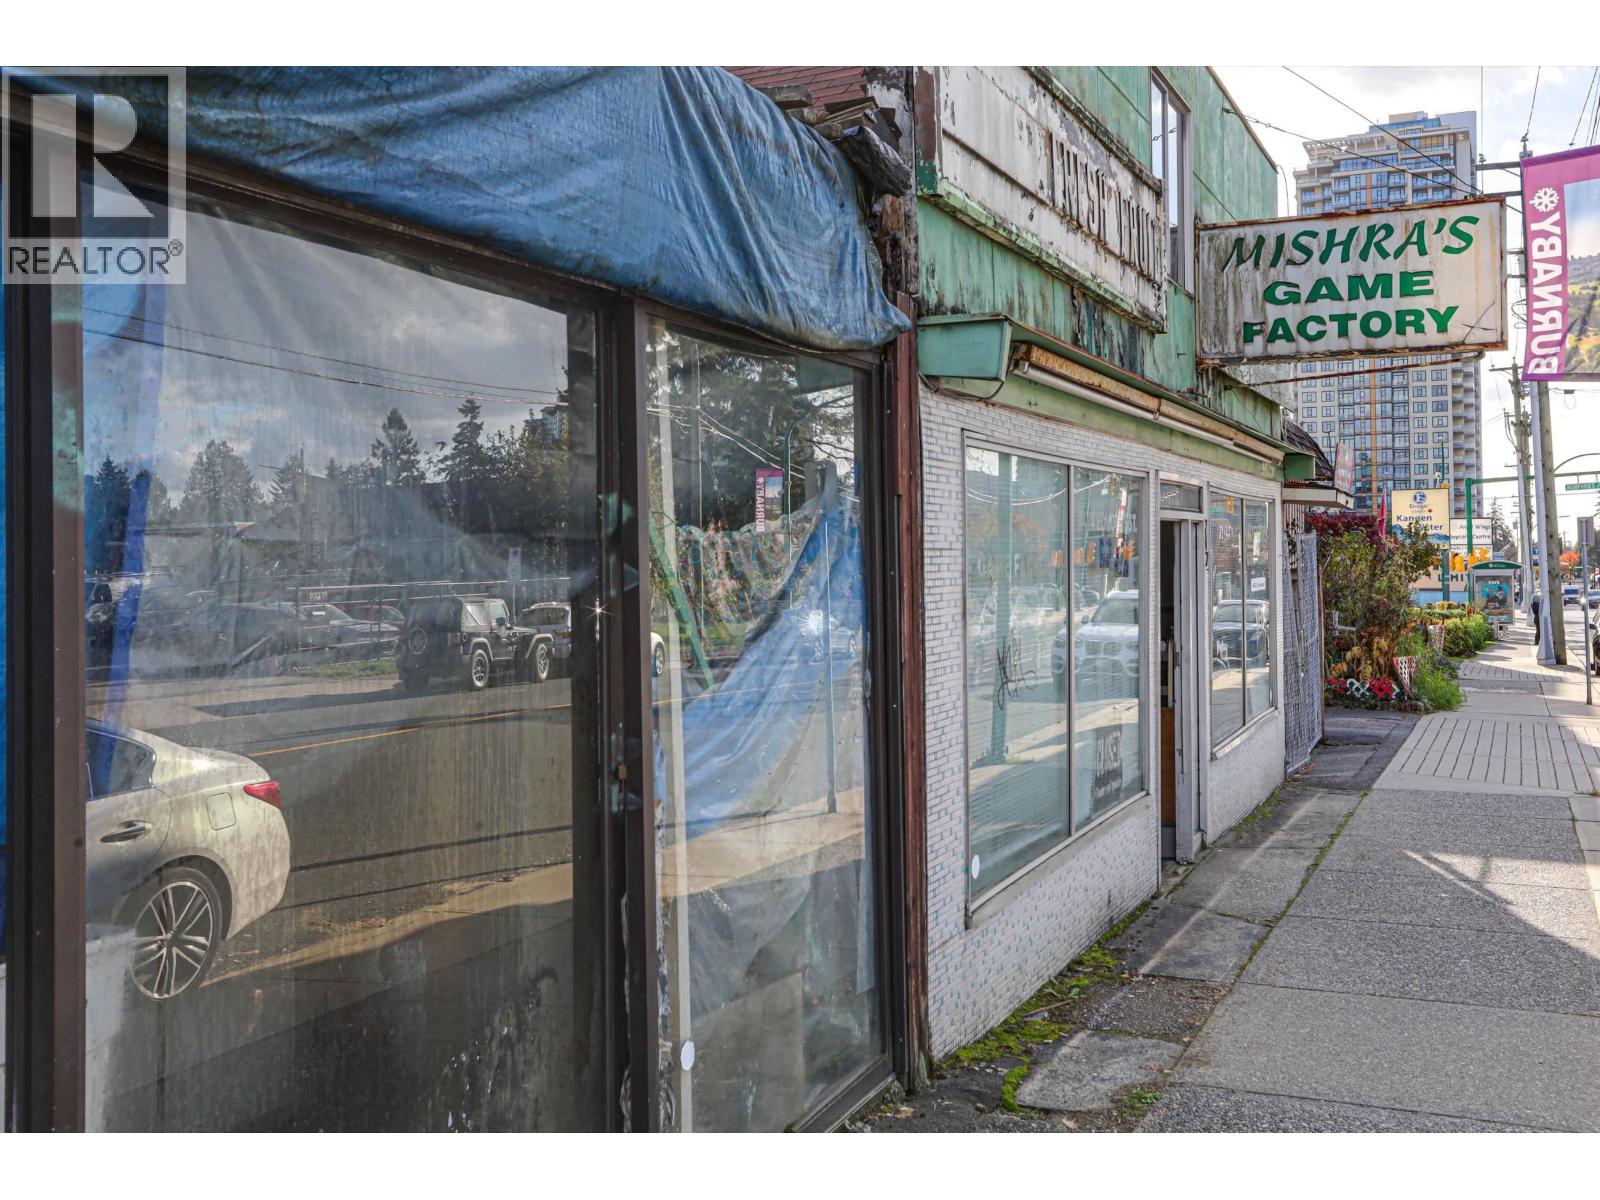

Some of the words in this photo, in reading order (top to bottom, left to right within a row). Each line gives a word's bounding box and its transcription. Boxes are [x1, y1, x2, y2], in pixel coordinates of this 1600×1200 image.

[1221, 215, 1480, 272] MISHRA'S
[1263, 270, 1434, 305] GAME
[1243, 305, 1459, 344] FACTORY
[1396, 514, 1432, 523] Kangen
